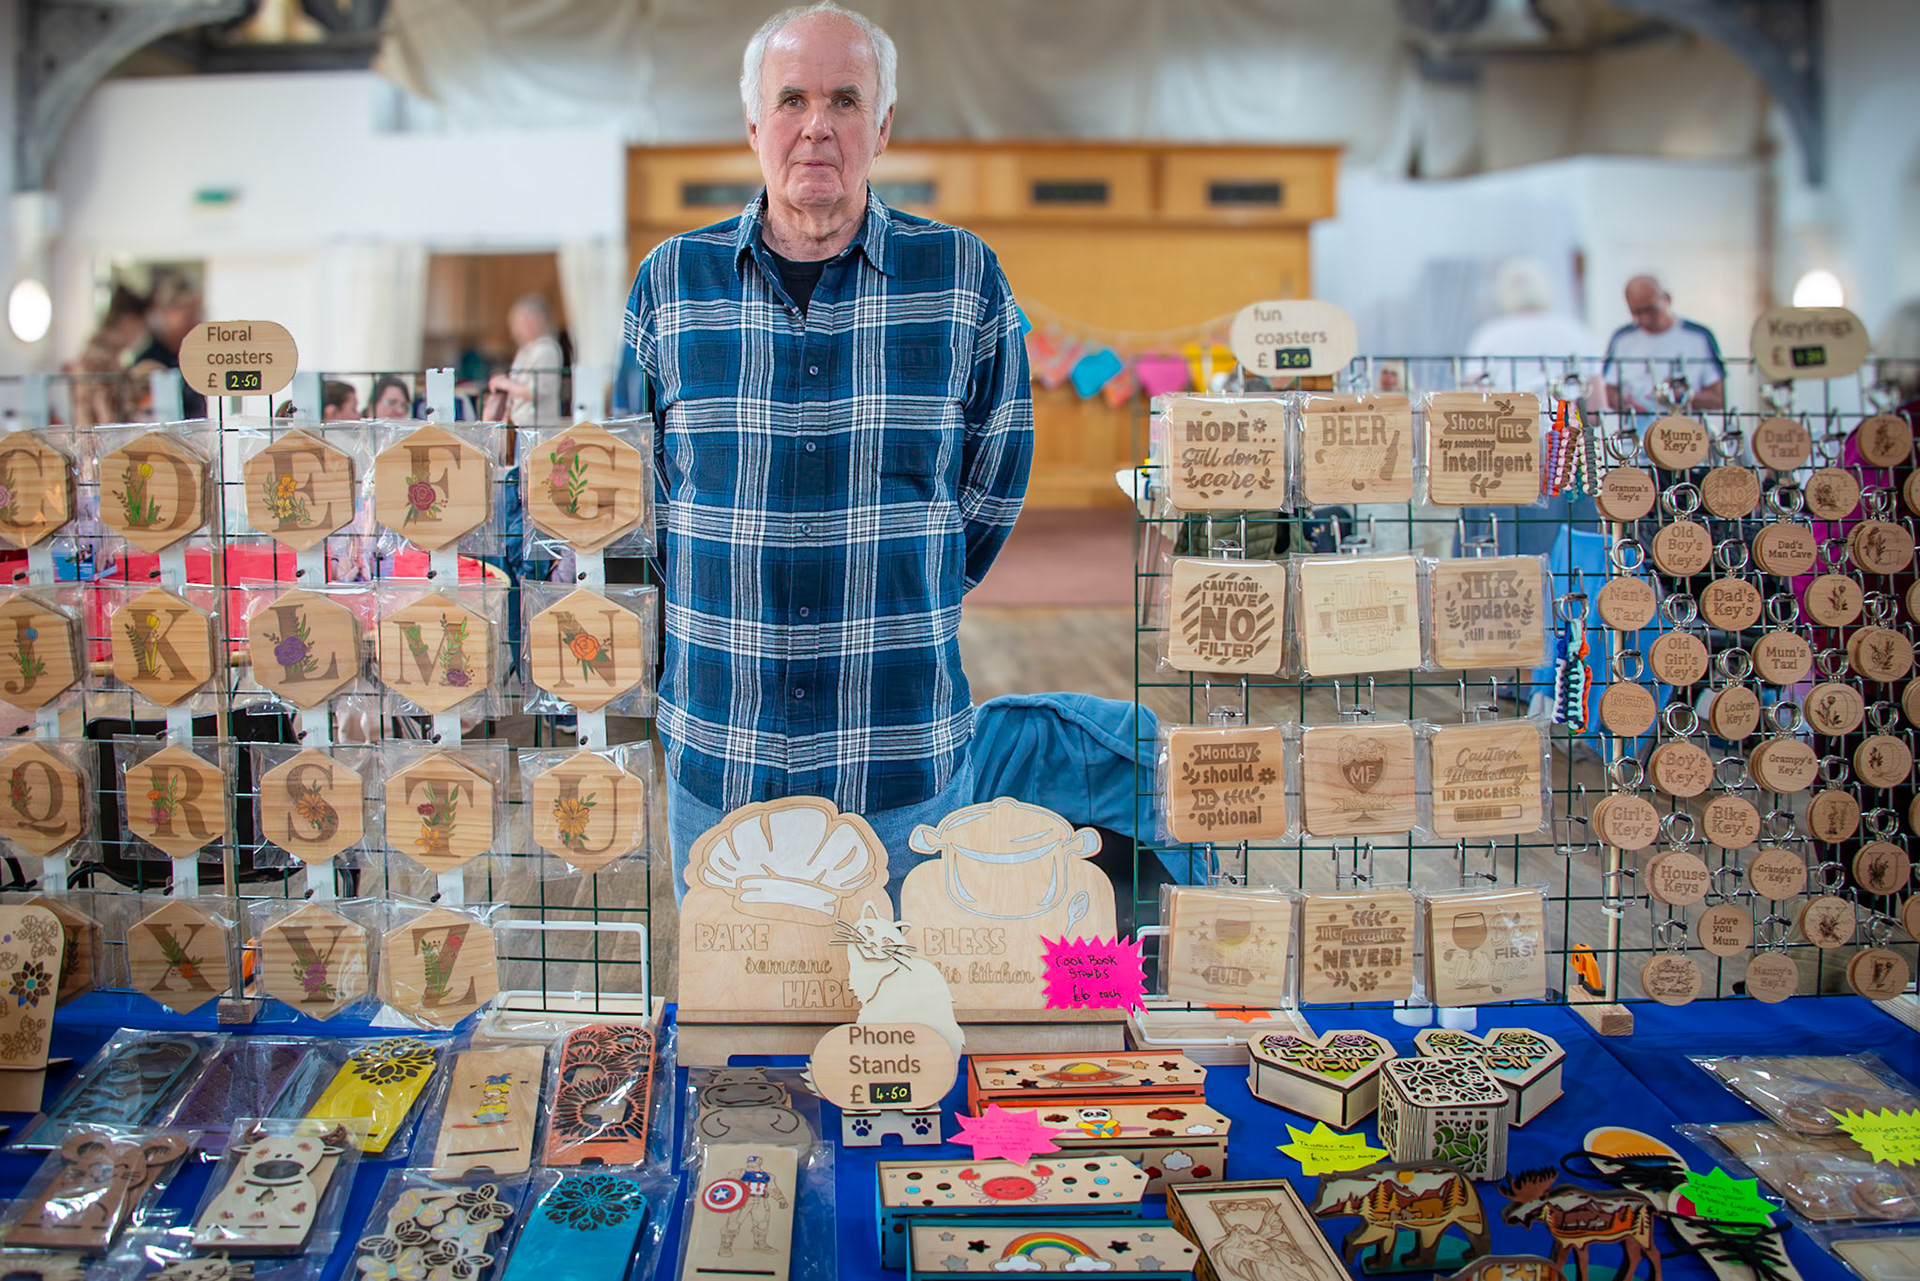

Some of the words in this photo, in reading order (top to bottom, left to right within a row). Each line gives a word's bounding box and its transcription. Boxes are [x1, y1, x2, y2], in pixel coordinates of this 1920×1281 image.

[1254, 305, 1282, 322] fun
[207, 325, 252, 341] Floral
[1768, 316, 1853, 339] Keyrings
[1255, 331, 1328, 345] coasters
[206, 350, 273, 365] coasters
[1258, 352, 1268, 368] £
[207, 372, 218, 388] £
[1450, 413, 1494, 430] Shock
[1321, 415, 1388, 446] BEER
[1499, 423, 1524, 439] me
[1660, 429, 1703, 441] Mum's
[1764, 429, 1805, 443] Dad's
[1439, 438, 1452, 451] Say
[1454, 438, 1497, 451] something
[1663, 440, 1697, 454] Key's
[1768, 445, 1801, 458] Taxi
[1181, 447, 1222, 468] Still
[1442, 450, 1533, 478] intelligent
[551, 442, 620, 520] G
[1200, 470, 1257, 490] care
[120, 449, 197, 531] D
[265, 449, 334, 532] E
[1617, 492, 1640, 503] Key's
[1671, 525, 1694, 538] Old
[1667, 538, 1703, 553] Boy's
[1777, 540, 1803, 550] Dad's
[1666, 554, 1703, 569] Key's
[1768, 550, 1788, 559] Man
[1791, 550, 1813, 559] Cave
[1470, 572, 1510, 598] Life
[1202, 591, 1206, 605] I
[1213, 592, 1258, 607] HAVE
[1713, 588, 1755, 602] Dad's
[1337, 607, 1387, 621] NEEDS
[1460, 600, 1521, 626] update
[1713, 602, 1754, 620] Key's
[1199, 606, 1256, 642] NO
[1464, 627, 1485, 641] still
[1487, 630, 1494, 640] a
[1497, 628, 1522, 639] mess
[127, 608, 197, 681] K
[269, 603, 339, 684] L
[549, 609, 621, 688] N
[1198, 642, 1254, 658] FILTER
[1668, 637, 1690, 650] Old
[1765, 646, 1806, 658] Mum's
[4, 614, 37, 694] J
[393, 620, 470, 687] M
[1664, 653, 1698, 666] Girl's
[1771, 659, 1798, 670] Taxi
[1664, 666, 1699, 681] Key's
[1724, 700, 1756, 713] Locker
[1726, 712, 1751, 726] Key's
[1200, 743, 1253, 762] Monday
[1665, 751, 1708, 771] Boy's
[1769, 753, 1813, 765] Grampy's
[1203, 764, 1254, 784] should
[1349, 765, 1376, 784] ME
[1665, 769, 1707, 787] Key's
[1777, 765, 1803, 777] Key's
[10, 759, 68, 838] Q
[144, 762, 217, 840] R
[286, 762, 340, 842] S
[1198, 791, 1215, 807] be
[1442, 790, 1455, 802] IN
[405, 776, 474, 859] T
[552, 773, 626, 855] U
[1197, 806, 1262, 831] optional
[1611, 806, 1653, 822] Girl's
[1611, 822, 1653, 840] Key's
[1711, 820, 1754, 838] Key's
[1660, 864, 1707, 881] House
[1758, 864, 1802, 875] Grandad's
[1663, 880, 1699, 896] Keys
[1713, 915, 1739, 926] Love
[695, 924, 770, 952] BAKE
[1712, 924, 1733, 935] you
[923, 926, 1007, 957] BLESS
[1712, 936, 1739, 946] Mum
[143, 923, 217, 991] X
[278, 925, 347, 1003] Y
[744, 956, 833, 975] someone
[411, 923, 478, 1009] Z
[968, 961, 1036, 985] kitchen
[1208, 967, 1246, 987] FUEL
[849, 1025, 916, 1045] Phone
[1280, 1047, 1333, 1059] LOVE
[1334, 1046, 1383, 1059] YOU
[1449, 1045, 1501, 1056] LOVE
[1501, 1044, 1549, 1056] YOU
[849, 1054, 921, 1074] Stands
[850, 1085, 864, 1103] £
